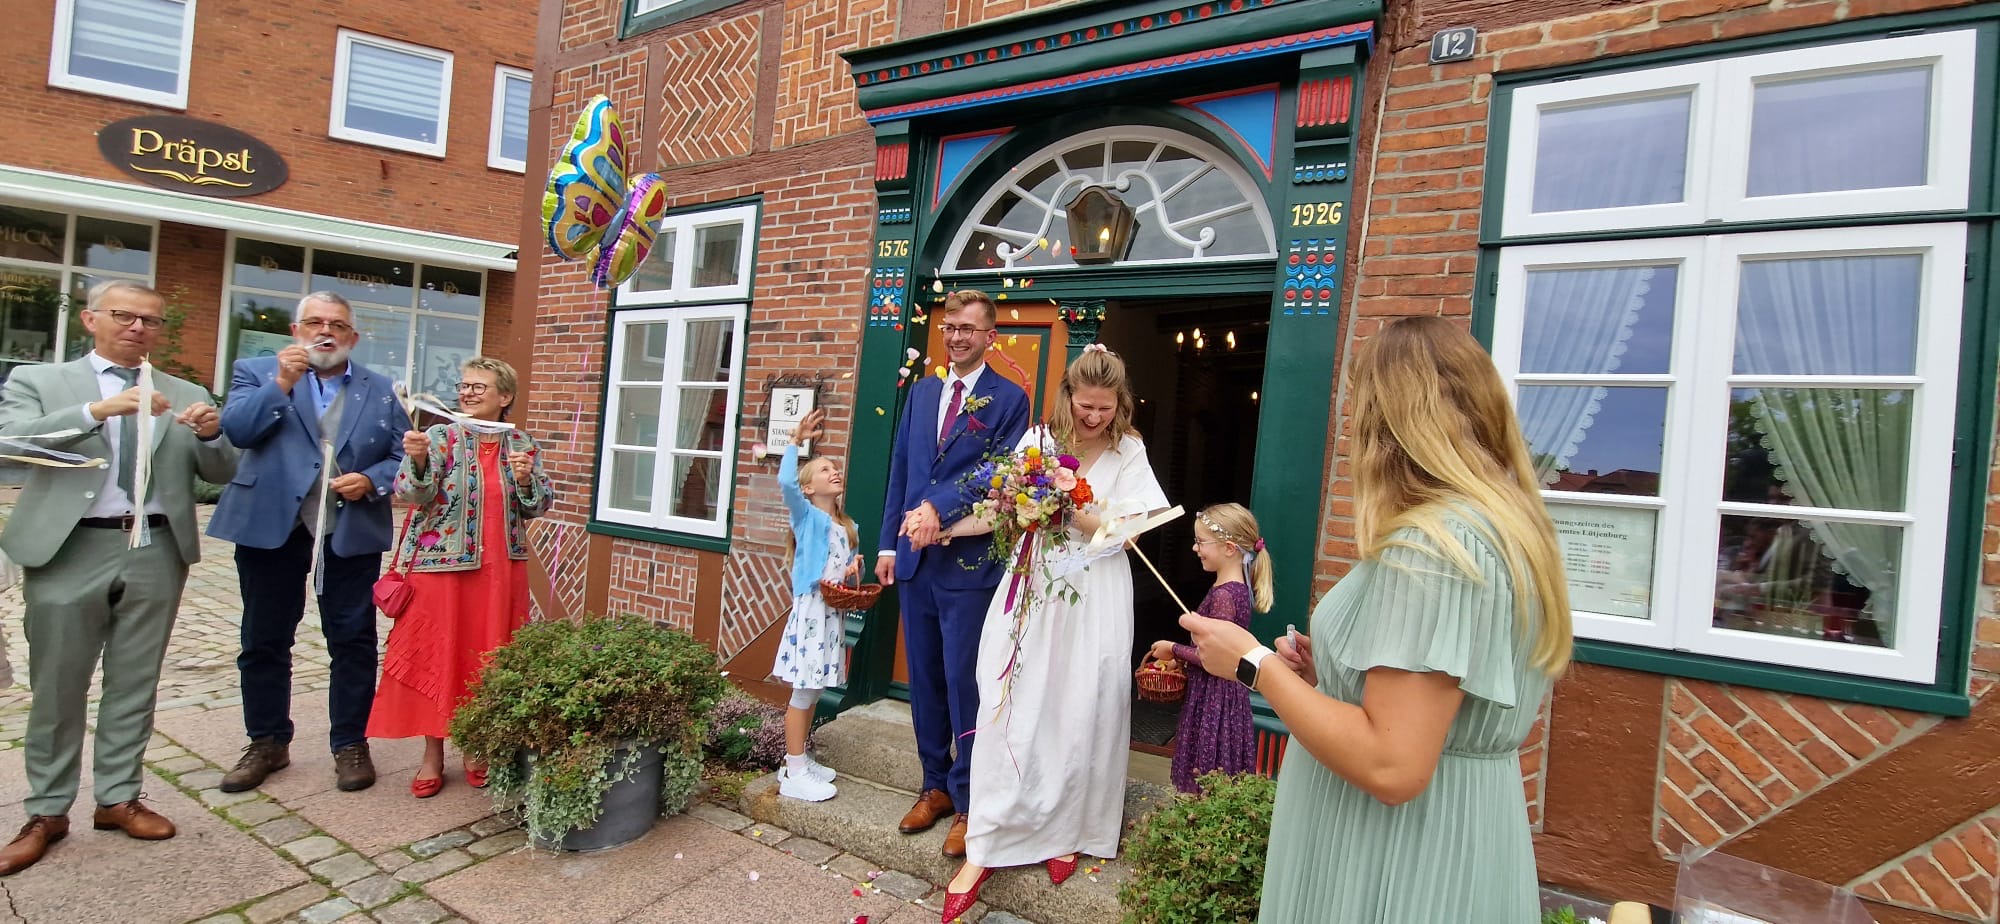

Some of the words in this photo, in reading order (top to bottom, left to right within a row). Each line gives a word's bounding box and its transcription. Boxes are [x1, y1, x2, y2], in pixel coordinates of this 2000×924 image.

[1439, 31, 1467, 58] 12
[129, 127, 256, 176] Präpst
[1291, 201, 1343, 227] 1926
[877, 239, 910, 258] 1576
